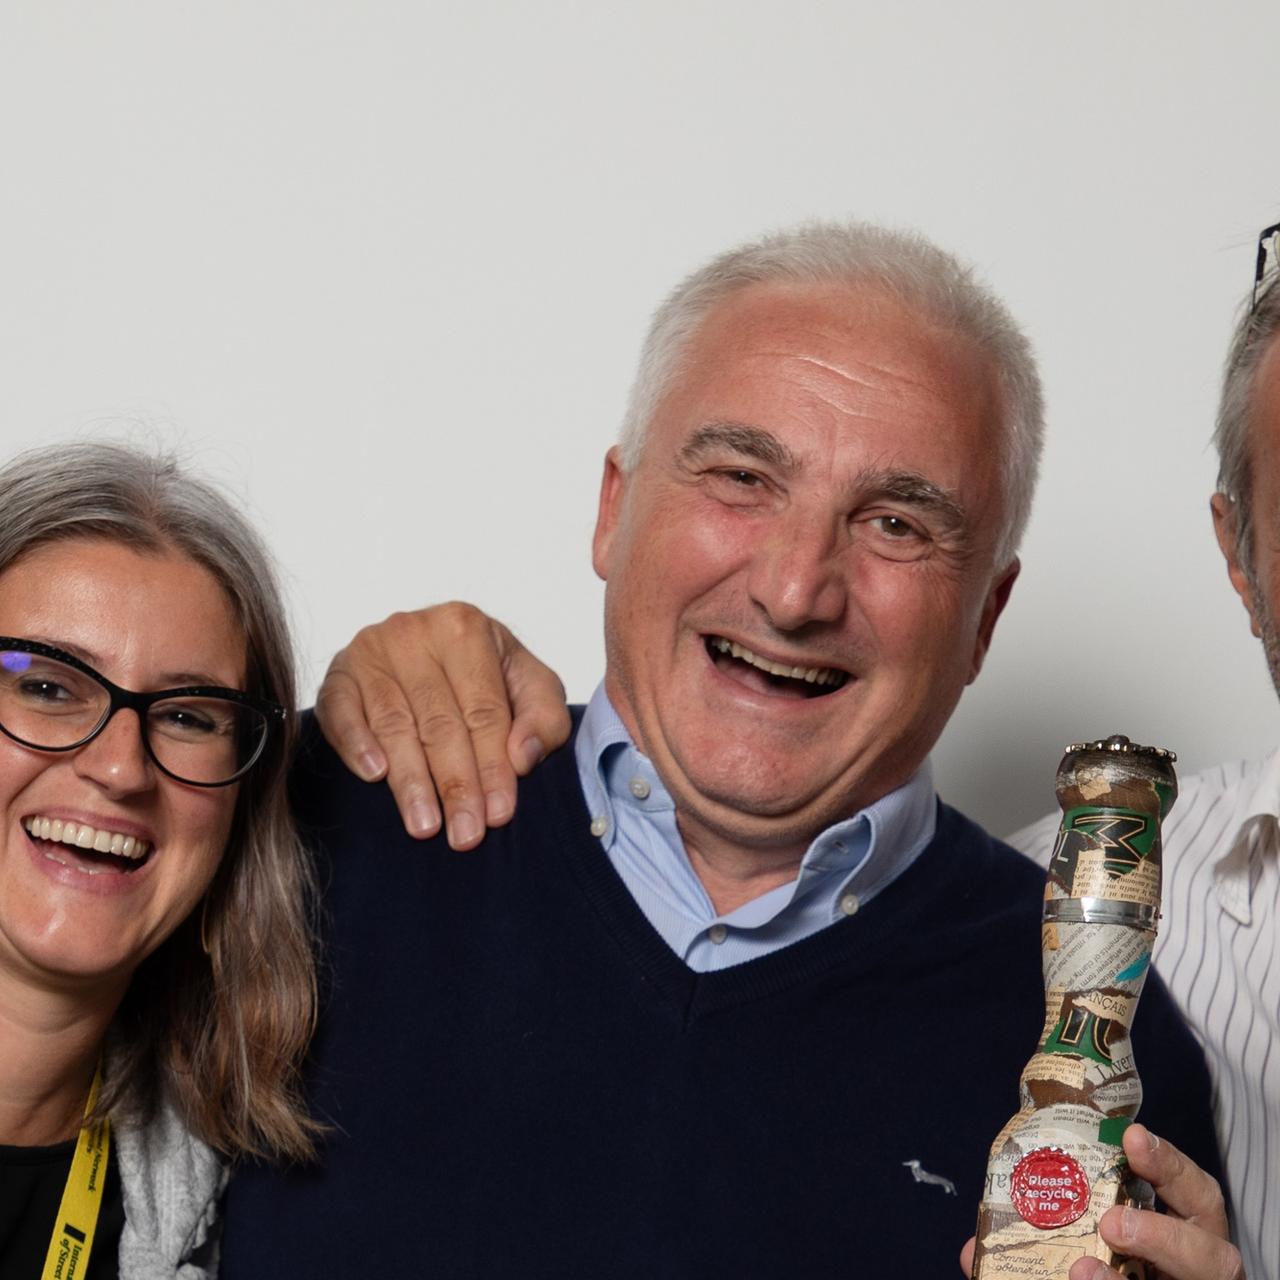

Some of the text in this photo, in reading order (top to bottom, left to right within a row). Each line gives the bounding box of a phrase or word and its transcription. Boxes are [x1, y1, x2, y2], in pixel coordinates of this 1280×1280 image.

[1028, 1175, 1073, 1186] Please
[1038, 1201, 1060, 1212] me
[60, 1238, 71, 1252] of
[54, 1249, 69, 1280] Street
[992, 1251, 1045, 1266] Comment
[996, 1263, 1034, 1276] obtenir
